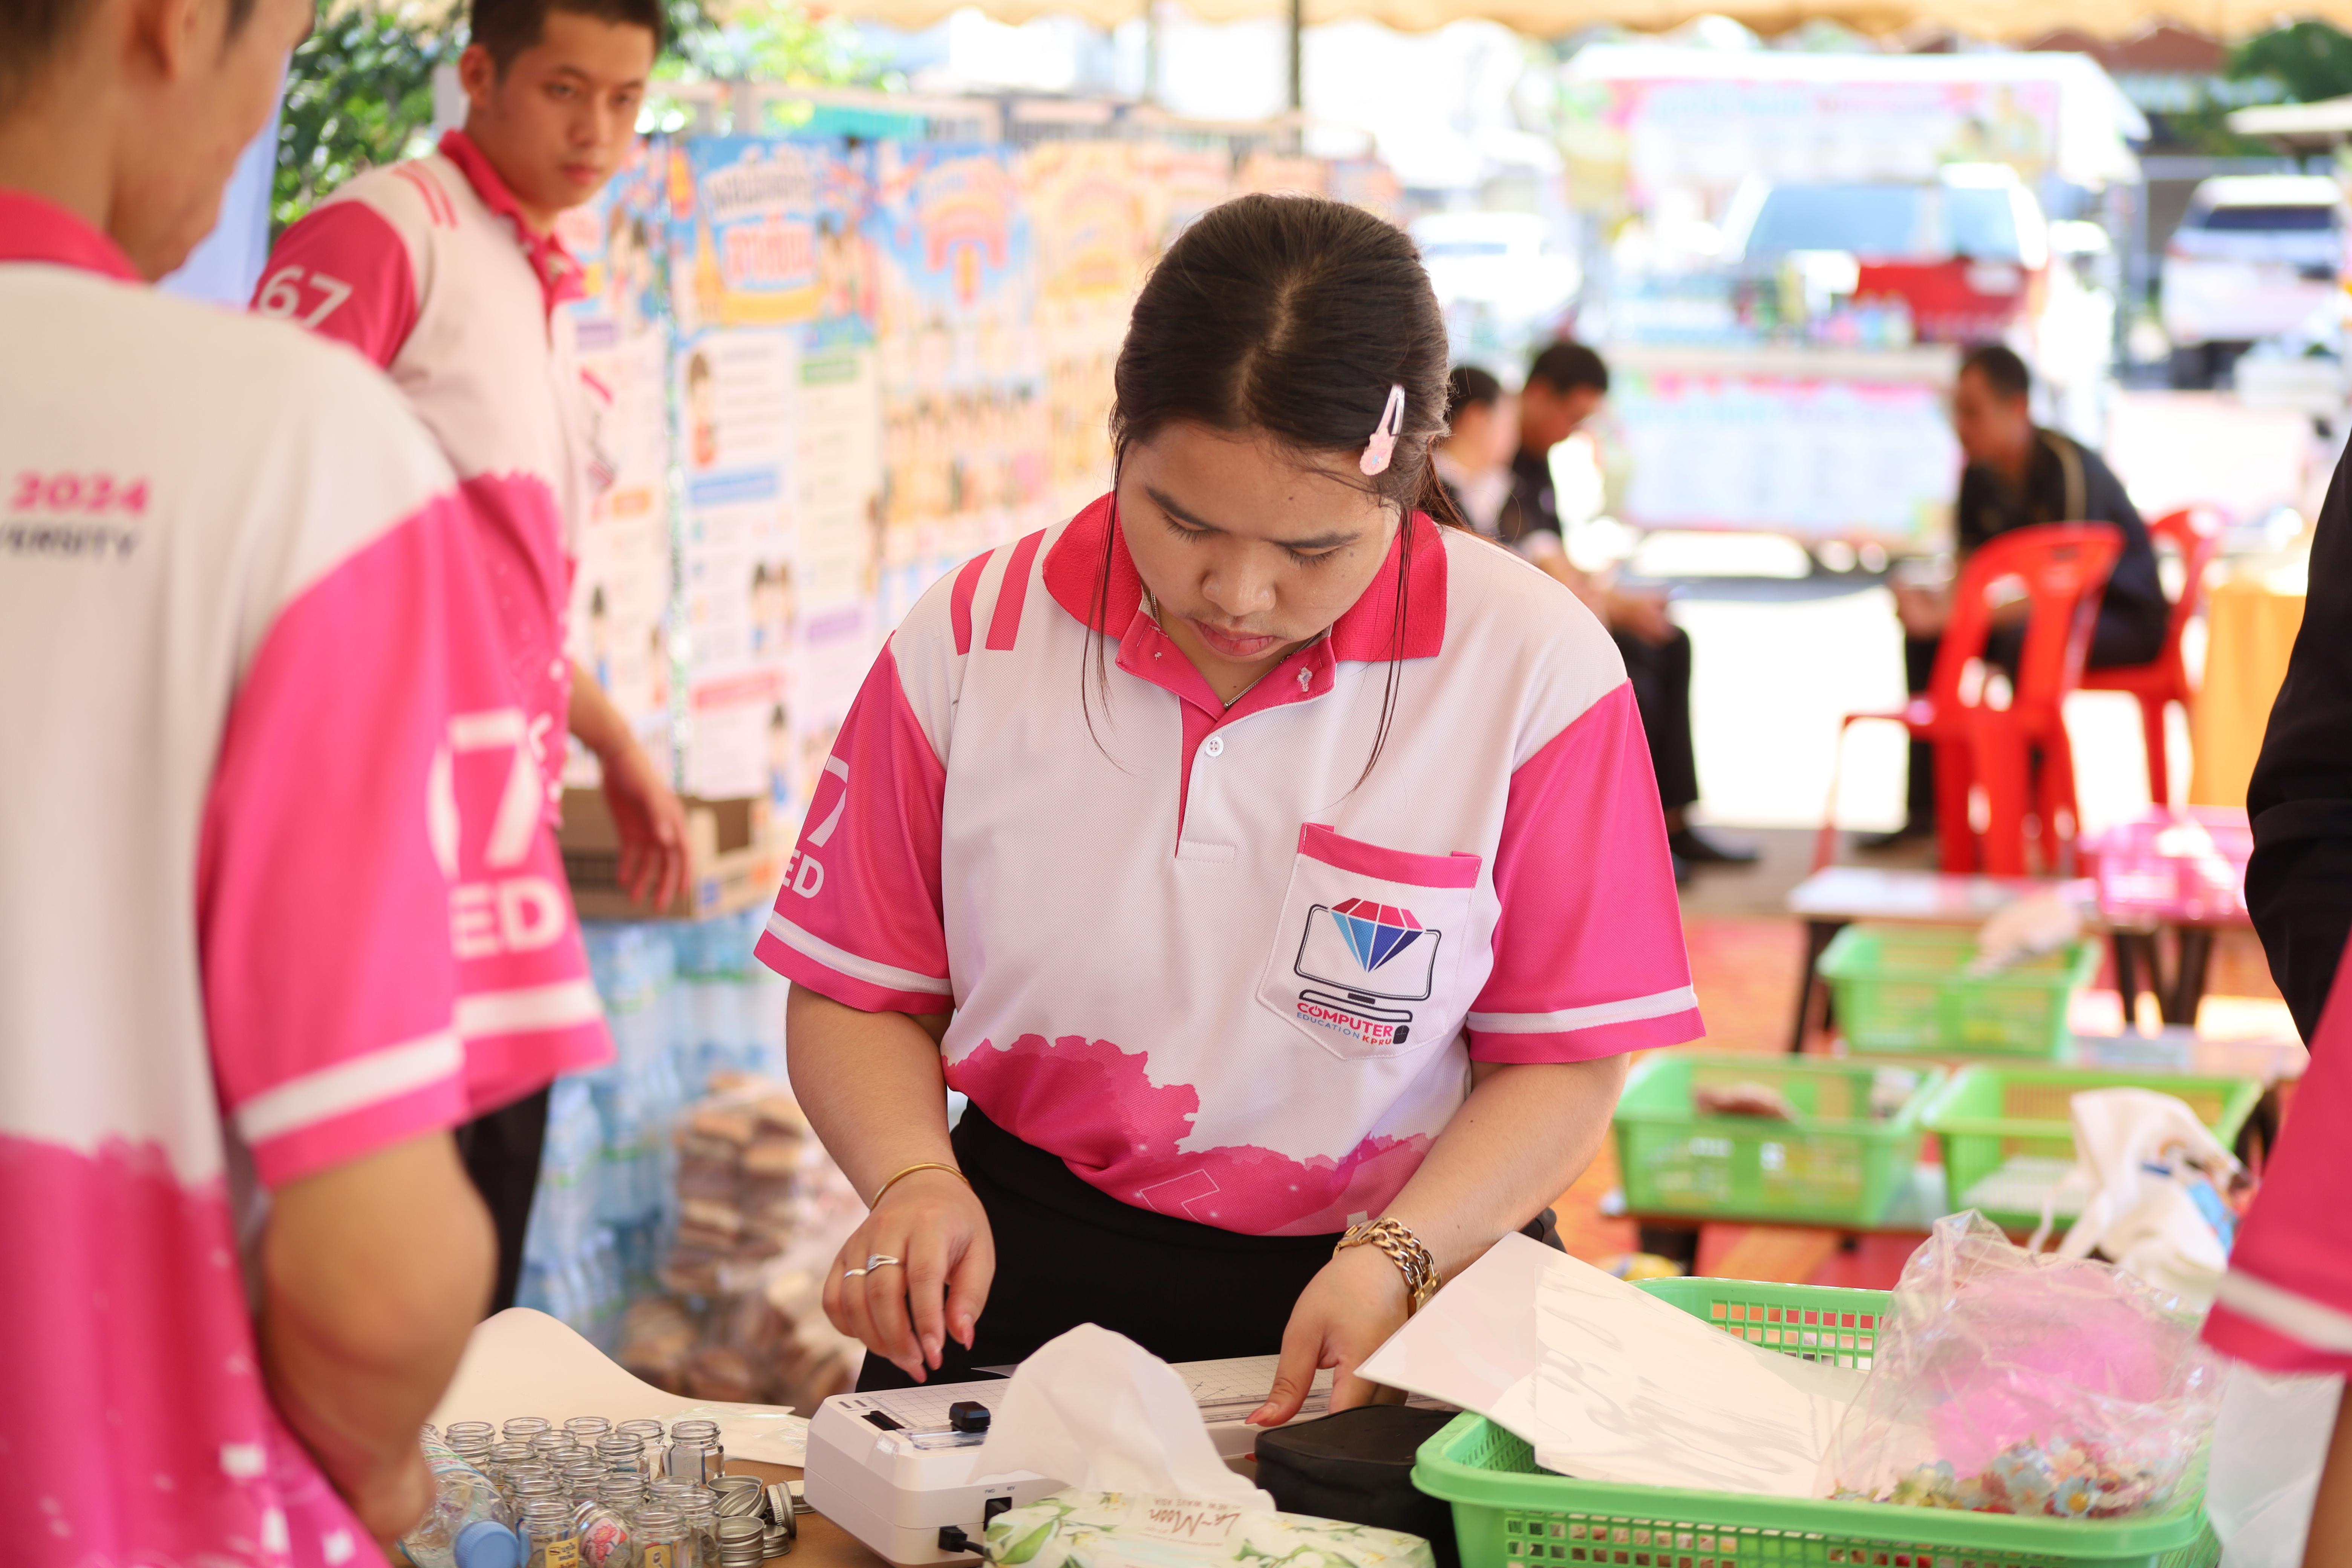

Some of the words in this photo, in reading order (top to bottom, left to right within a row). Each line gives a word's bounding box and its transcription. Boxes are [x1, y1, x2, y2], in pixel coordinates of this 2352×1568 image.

[259, 265, 354, 330] 67
[9, 469, 152, 519] 2024
[0, 525, 139, 562] VERSITY
[449, 876, 567, 961] ED
[1297, 1003, 1393, 1037] COMPUTER
[1297, 1012, 1361, 1039] EDUCATION
[1362, 1035, 1392, 1046] KPRU
